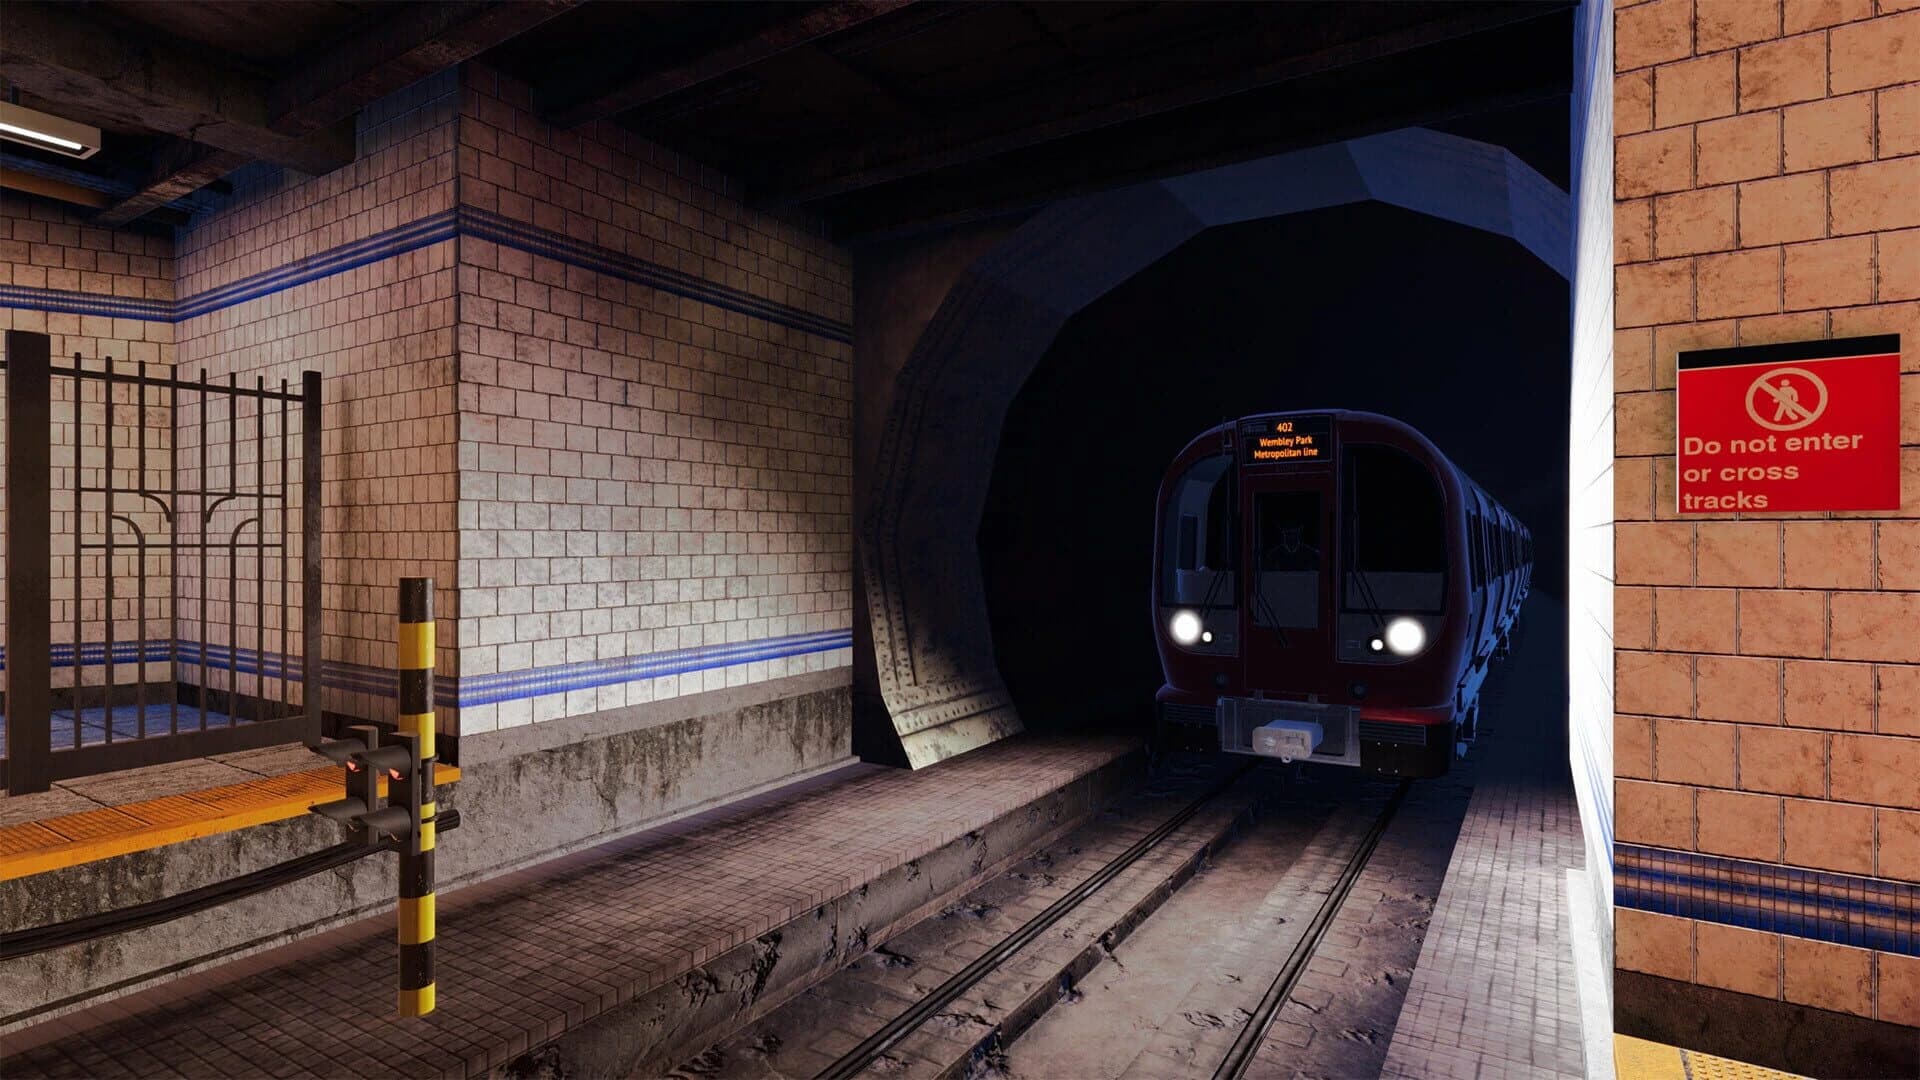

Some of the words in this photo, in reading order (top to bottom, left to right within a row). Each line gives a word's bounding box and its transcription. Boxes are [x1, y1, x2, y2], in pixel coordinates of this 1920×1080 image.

[1276, 422, 1293, 432] 402
[1260, 438, 1294, 447] Wembley
[1296, 436, 1313, 444] Park
[1684, 437, 1721, 455] Do
[1730, 435, 1777, 454] not
[1785, 433, 1863, 451] enter
[1254, 448, 1301, 459] Metropolitan
[1683, 468, 1712, 482] or
[1720, 466, 1799, 481] cross
[1683, 491, 1768, 509] tracks
